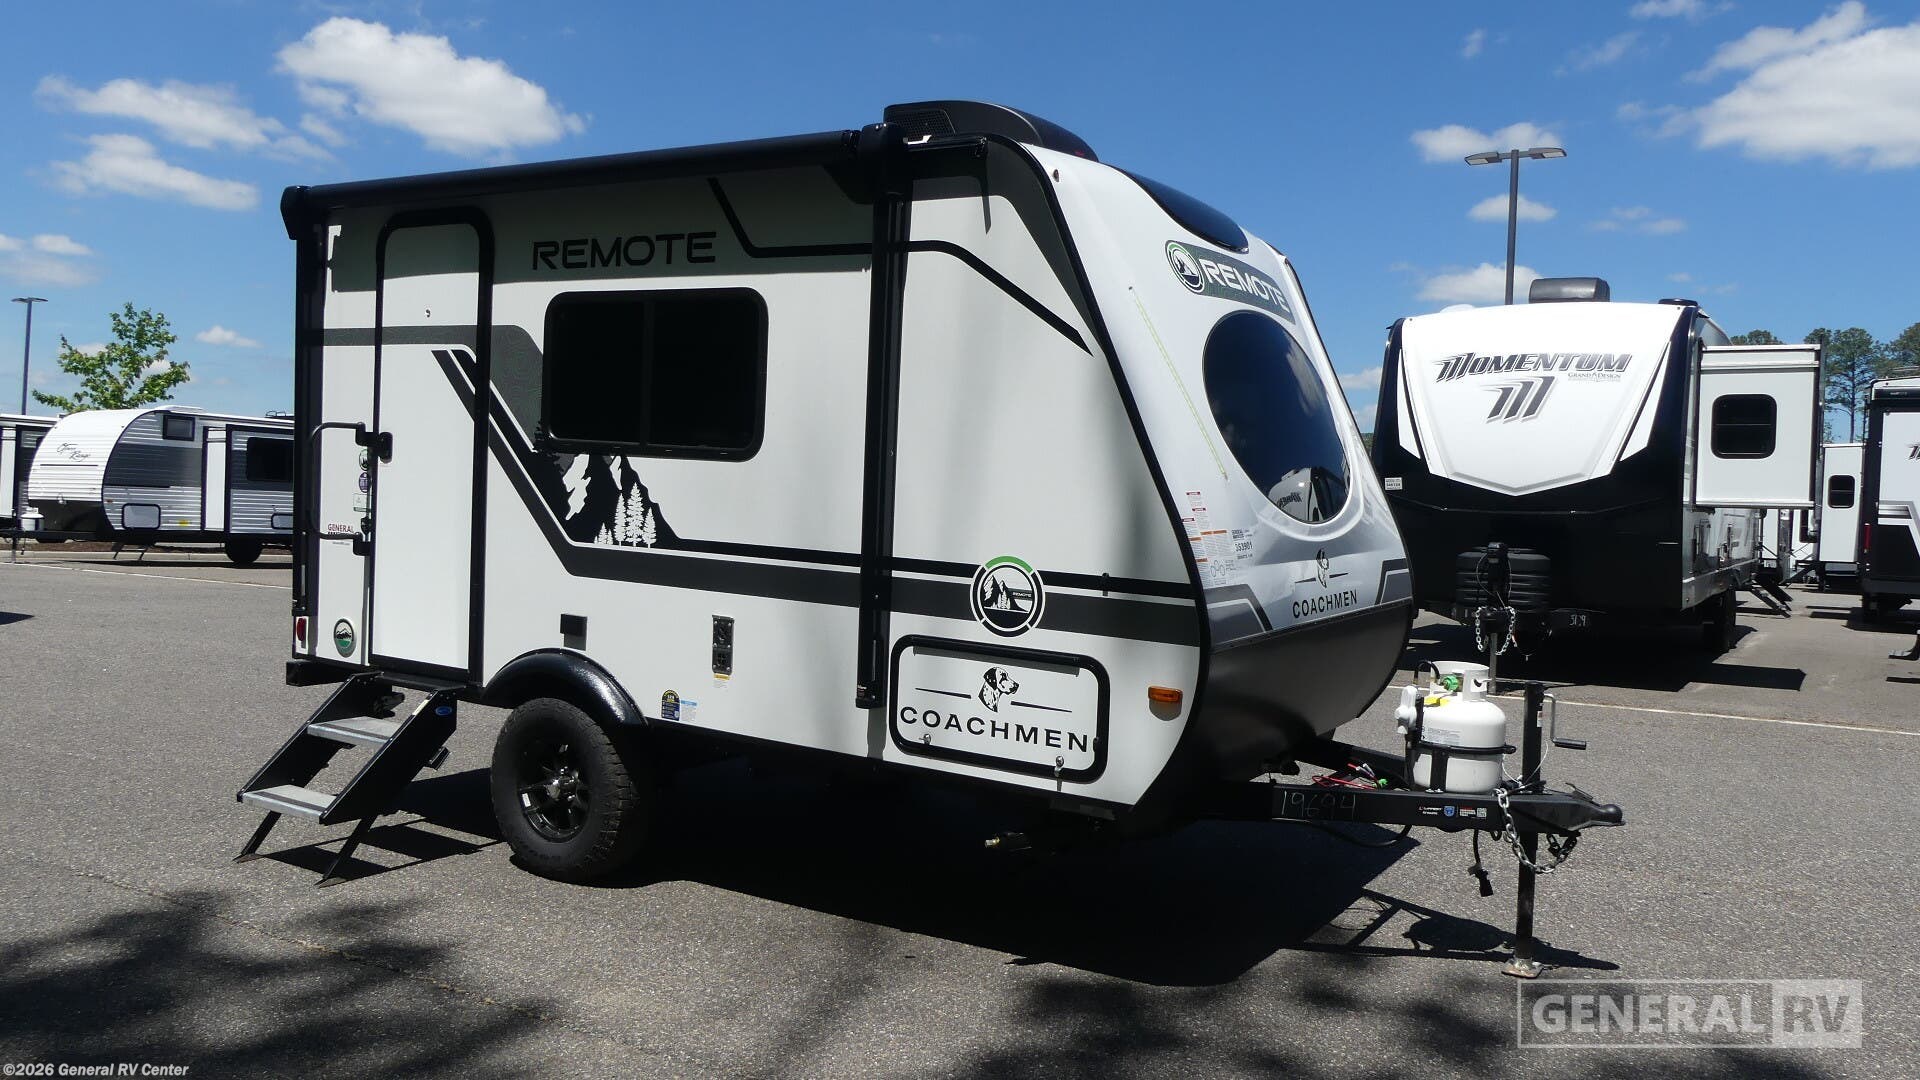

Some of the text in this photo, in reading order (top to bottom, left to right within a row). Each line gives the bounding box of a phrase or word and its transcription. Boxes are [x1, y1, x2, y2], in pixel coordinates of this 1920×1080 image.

[532, 232, 717, 270] REMOTE
[1199, 258, 1290, 313] REMOTE
[1433, 352, 1633, 383] MOMENTUM
[328, 523, 354, 533] GENERAL
[1292, 589, 1358, 619] COACHMEN
[900, 706, 1088, 753] COACHMEN
